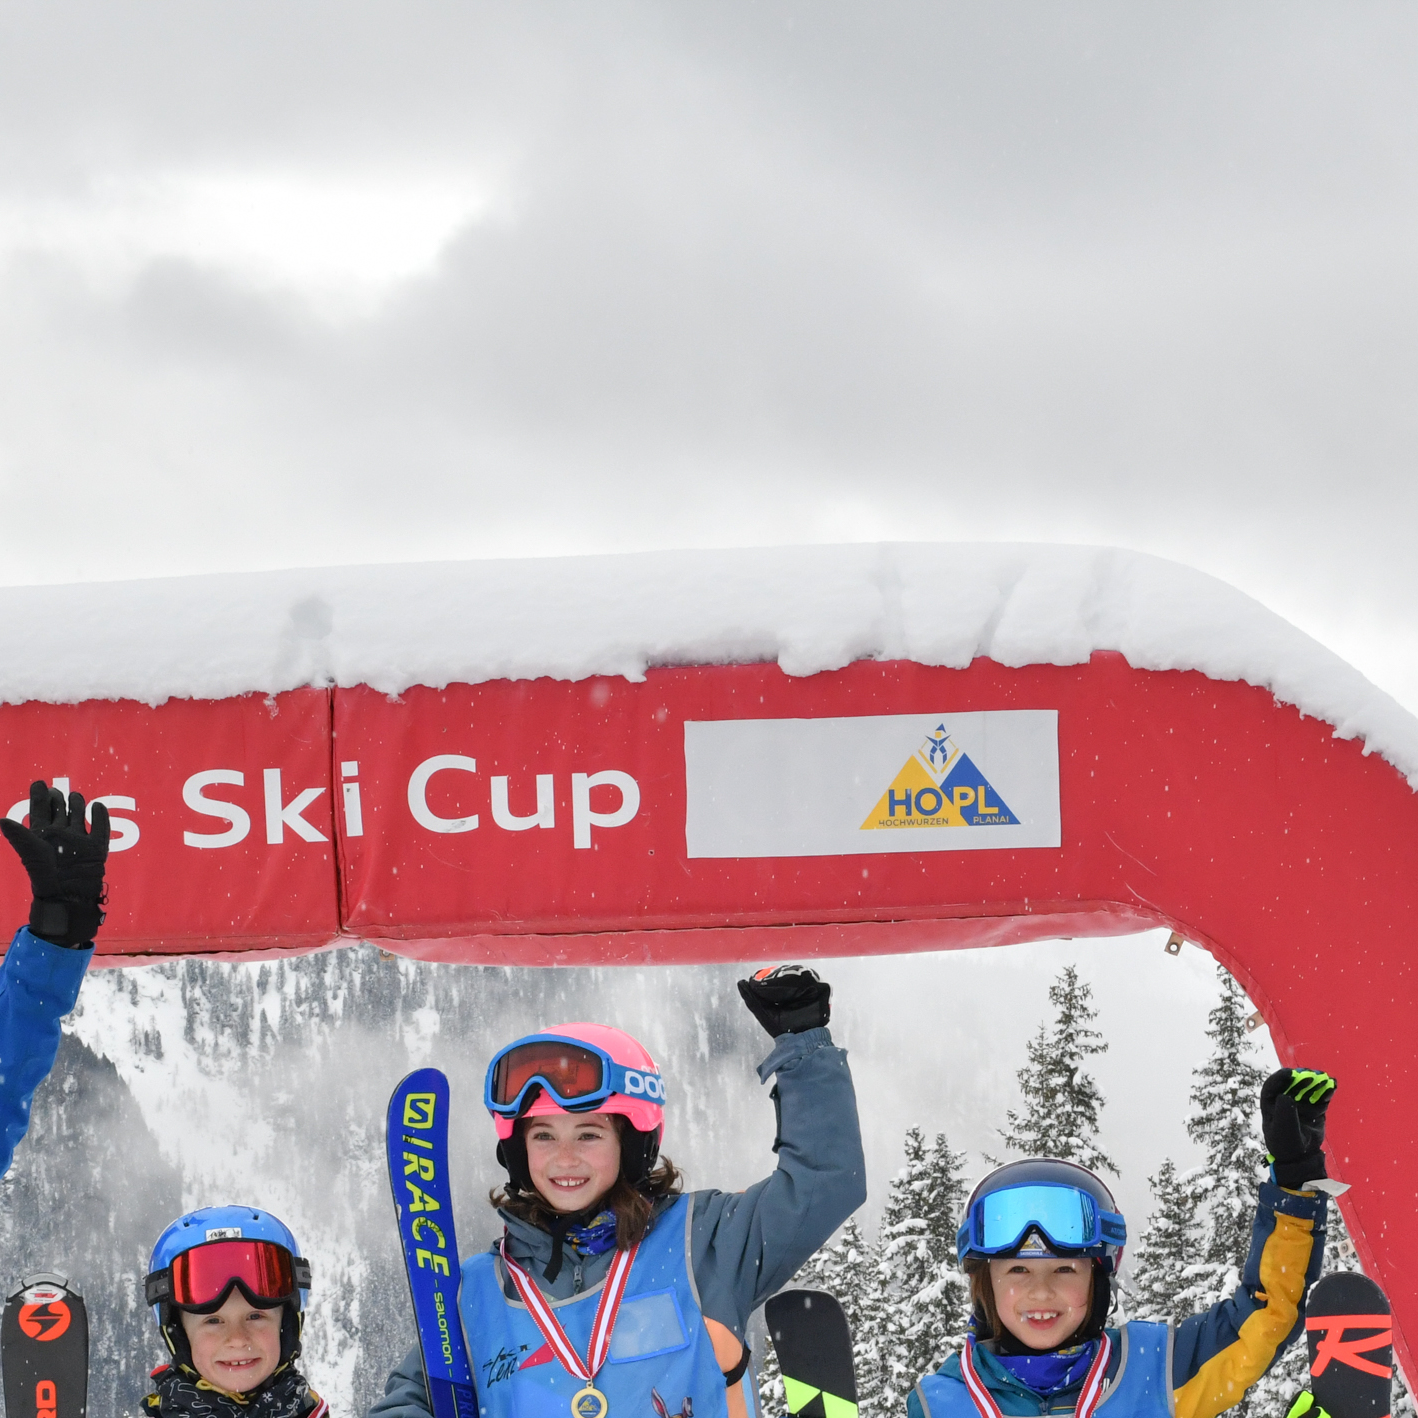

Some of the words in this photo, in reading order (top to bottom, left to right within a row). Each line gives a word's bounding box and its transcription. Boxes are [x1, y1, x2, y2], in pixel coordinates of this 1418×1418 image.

[182, 760, 366, 850] Ski
[406, 753, 642, 850] Cup
[878, 817, 950, 828] HOCHWURZEN
[973, 814, 1011, 825] PLANAI
